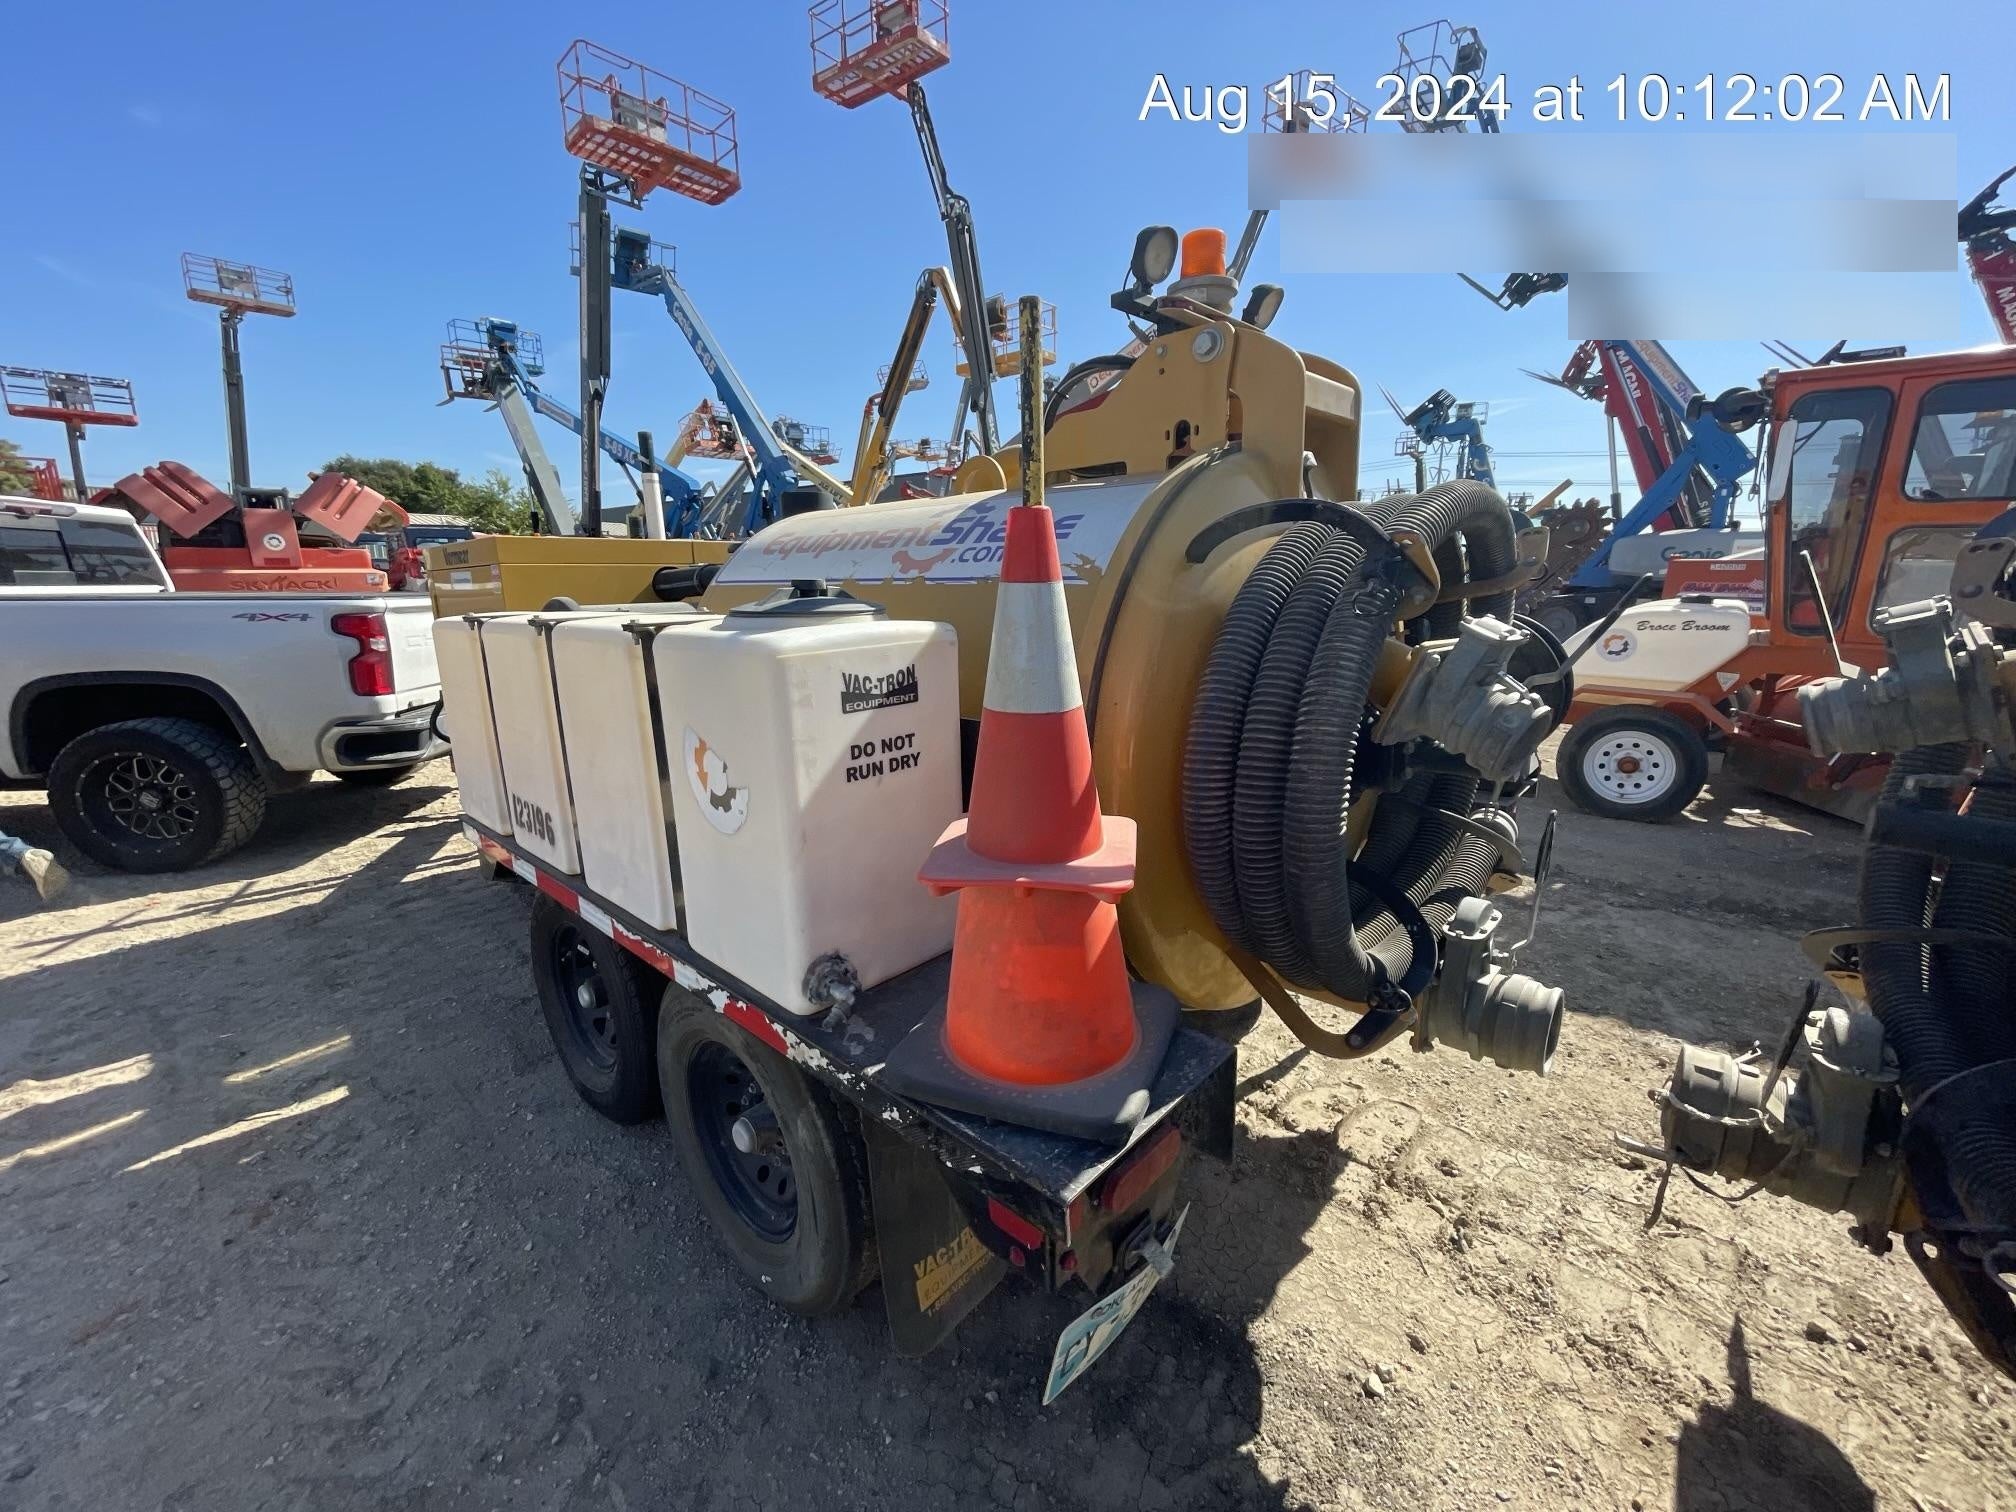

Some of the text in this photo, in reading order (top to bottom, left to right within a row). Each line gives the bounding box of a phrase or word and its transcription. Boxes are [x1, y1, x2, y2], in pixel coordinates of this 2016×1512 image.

[1636, 620, 1731, 631] Broce Broom
[841, 663, 917, 695] VAC-TRON
[845, 693, 917, 712] EQUIPMENT
[850, 733, 916, 760] DO NOT
[846, 752, 921, 783] RUN DRY
